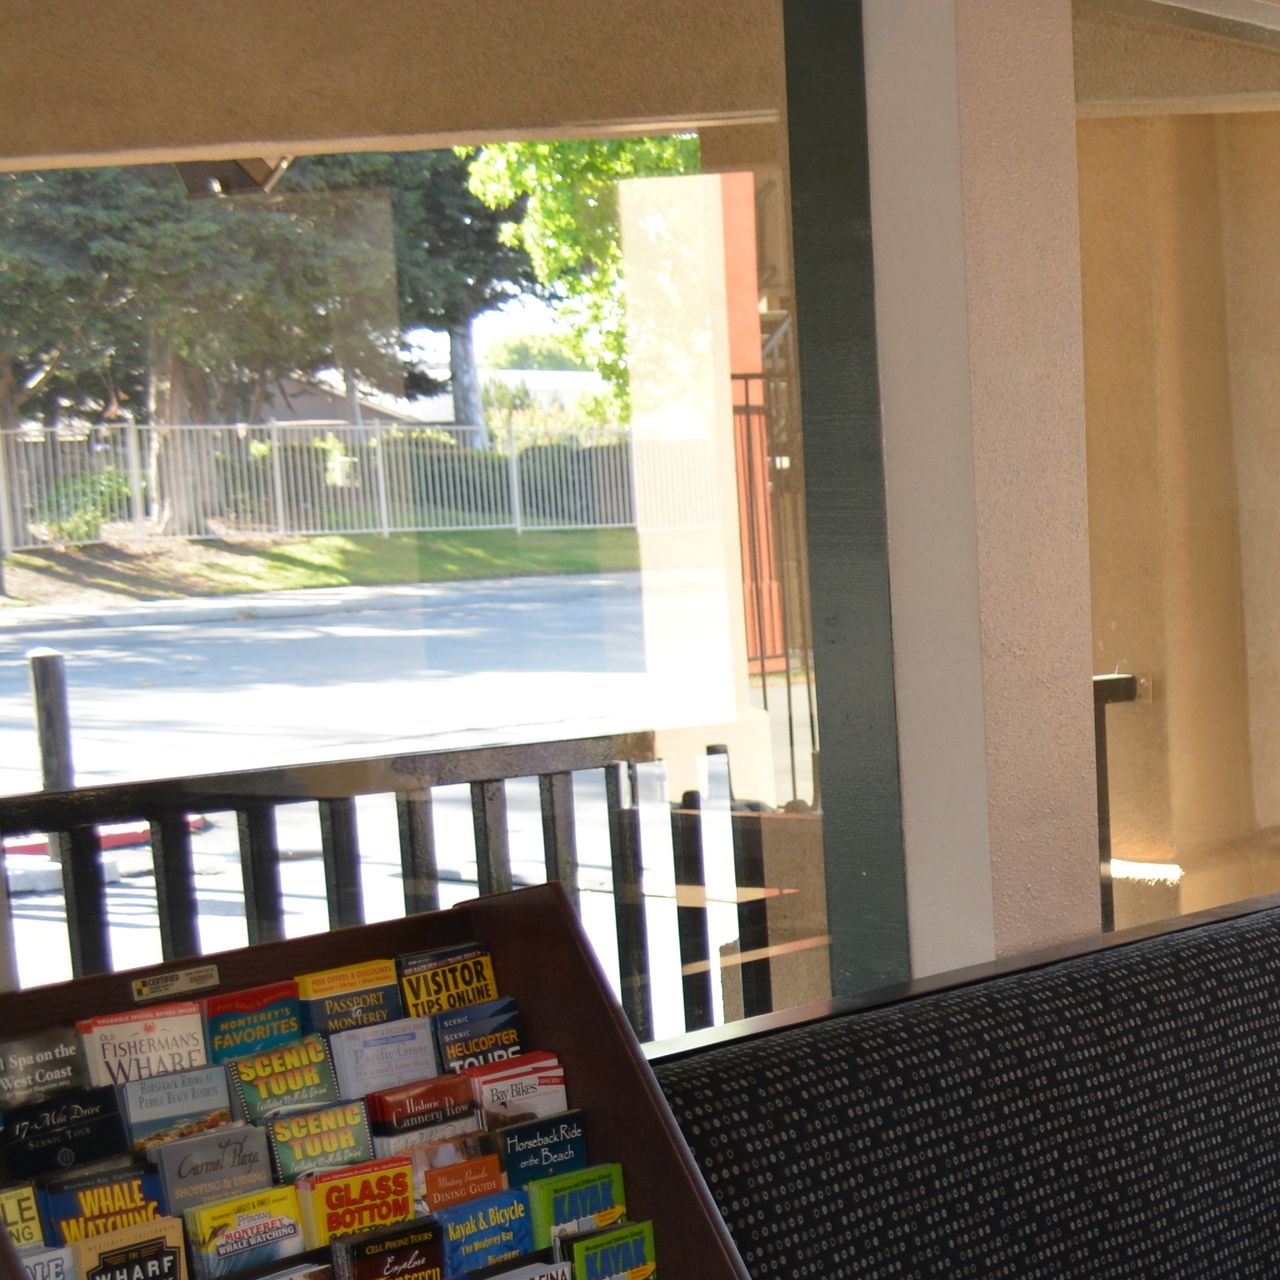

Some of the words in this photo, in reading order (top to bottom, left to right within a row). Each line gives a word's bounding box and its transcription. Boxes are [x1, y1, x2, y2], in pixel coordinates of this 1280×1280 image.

[406, 956, 488, 1001] VISITOR
[325, 991, 385, 1015] PASSPORT
[411, 996, 443, 1018] TIPS
[449, 983, 493, 1009] ONLINE
[214, 1018, 299, 1050] FAVORITES
[220, 1007, 292, 1032] MONTEREY'S
[328, 1009, 389, 1033] MONTEREY
[9, 1052, 36, 1071] Spa
[36, 1050, 54, 1062] on
[56, 1044, 76, 1058] the
[101, 1032, 200, 1060] FISHERMAN'S
[447, 1028, 520, 1058] HELICOPTER
[238, 1036, 326, 1082] SCENIC
[0, 1072, 33, 1091] West
[36, 1066, 73, 1083] Coast
[252, 1065, 322, 1099] TOUR
[490, 1086, 510, 1103] Bay
[510, 1081, 538, 1098] Bikes
[393, 1107, 443, 1130] Cannery
[445, 1097, 470, 1117] Row
[406, 1098, 438, 1115] Historic
[272, 1103, 362, 1143] SCENIC
[287, 1127, 357, 1161] TOUR
[507, 1133, 559, 1154] Horseback
[559, 1124, 583, 1139] Ride
[541, 1148, 575, 1166] Beach
[77, 1179, 146, 1219] WHALE
[325, 1172, 410, 1211] GLASS
[433, 1189, 467, 1205] DINING
[470, 1181, 497, 1195] GUIDE
[224, 1216, 286, 1243] MONTEREY
[327, 1197, 411, 1233] BOTTOM
[448, 1216, 477, 1242] Kayak
[478, 1210, 488, 1231] &
[489, 1200, 526, 1226] Bicycle
[218, 1238, 250, 1256] WHALE
[250, 1225, 295, 1245] WATCHING
[366, 1242, 384, 1255] CELL
[385, 1236, 408, 1250] PHONE
[409, 1231, 433, 1245] TOURS
